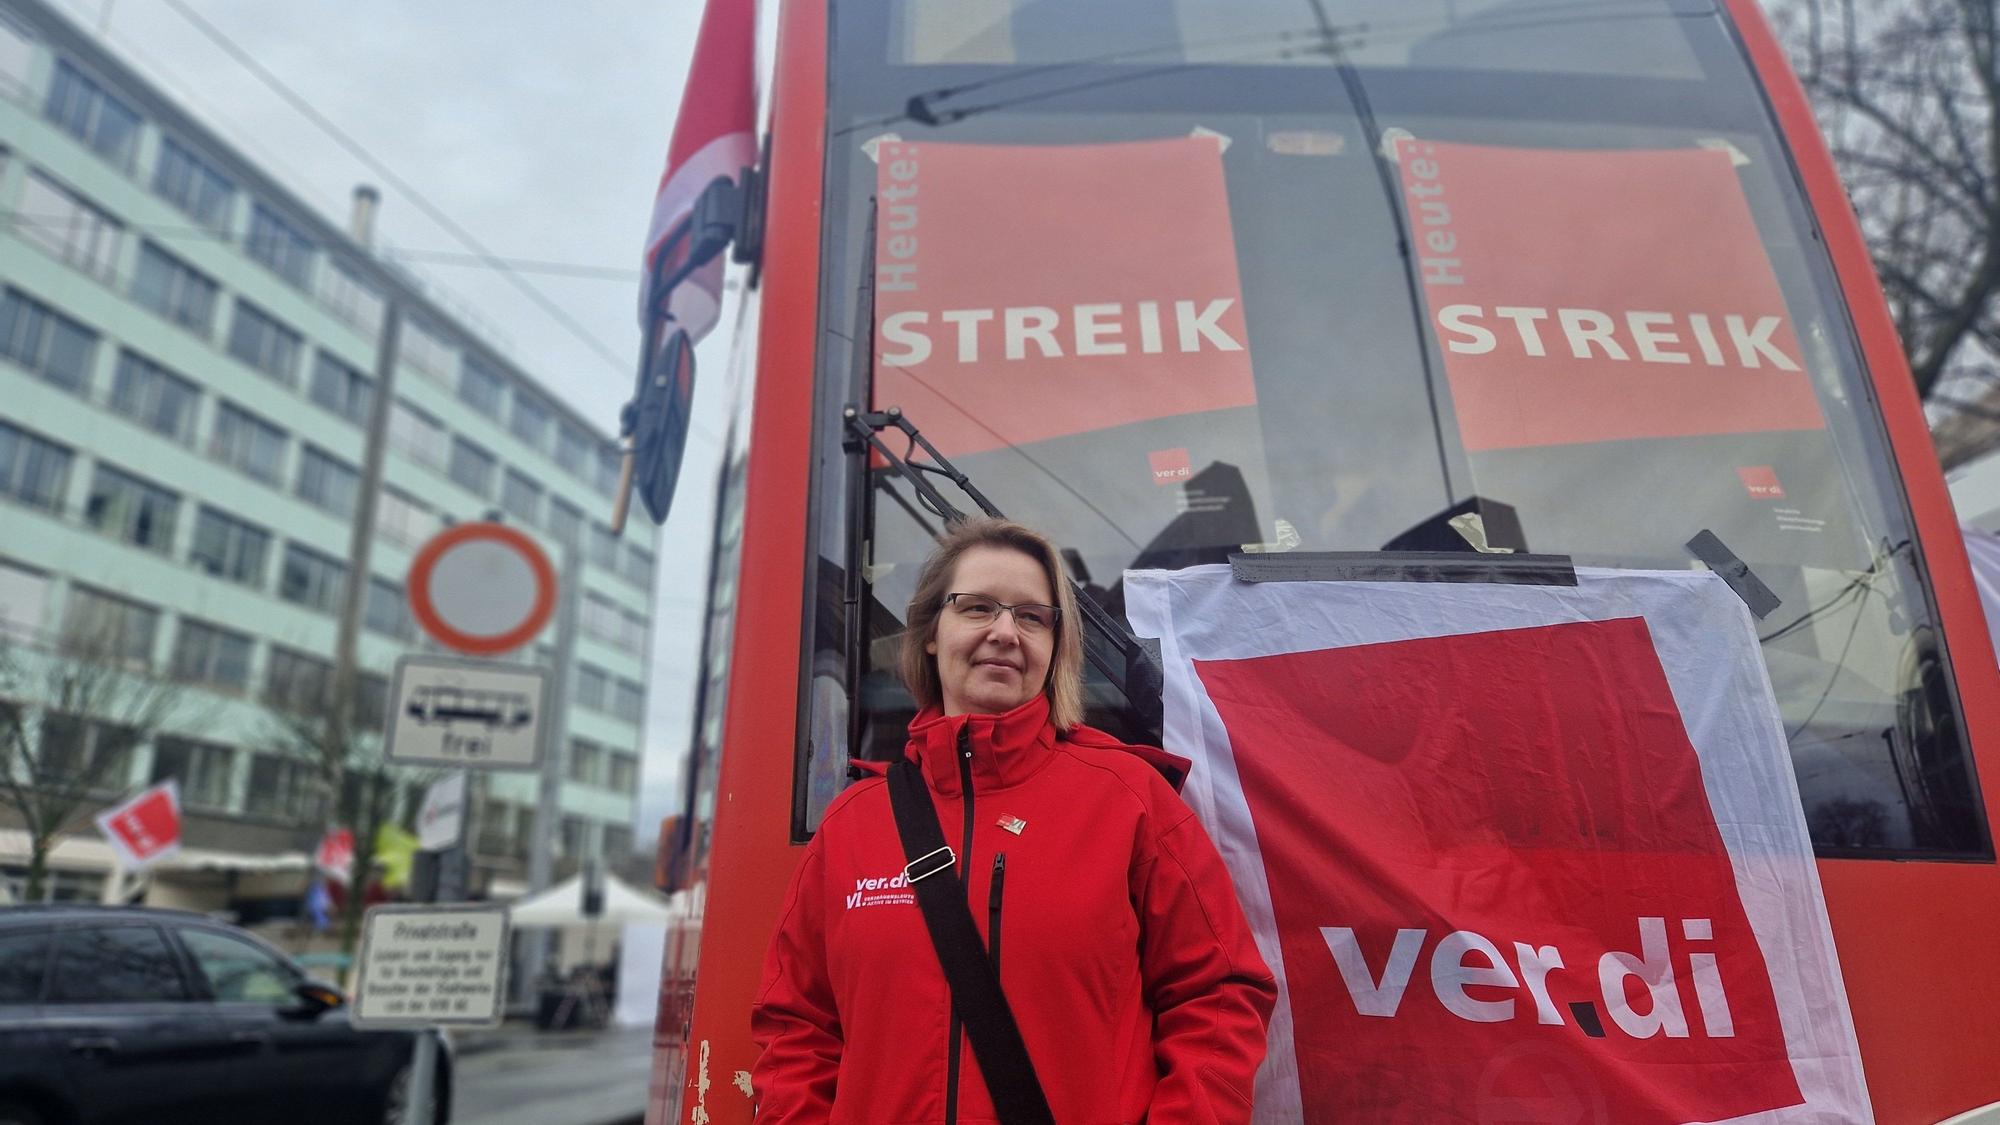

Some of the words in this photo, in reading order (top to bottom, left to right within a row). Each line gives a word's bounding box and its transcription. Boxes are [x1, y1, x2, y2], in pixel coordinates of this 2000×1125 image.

[879, 146, 918, 292] Heute:
[1408, 144, 1463, 285] Heute:
[881, 298, 1245, 367] STREIK
[1438, 304, 1802, 371] STREIK
[441, 732, 492, 756] frei
[857, 872, 908, 891] ver.di
[1319, 917, 1735, 1038] ver.di
